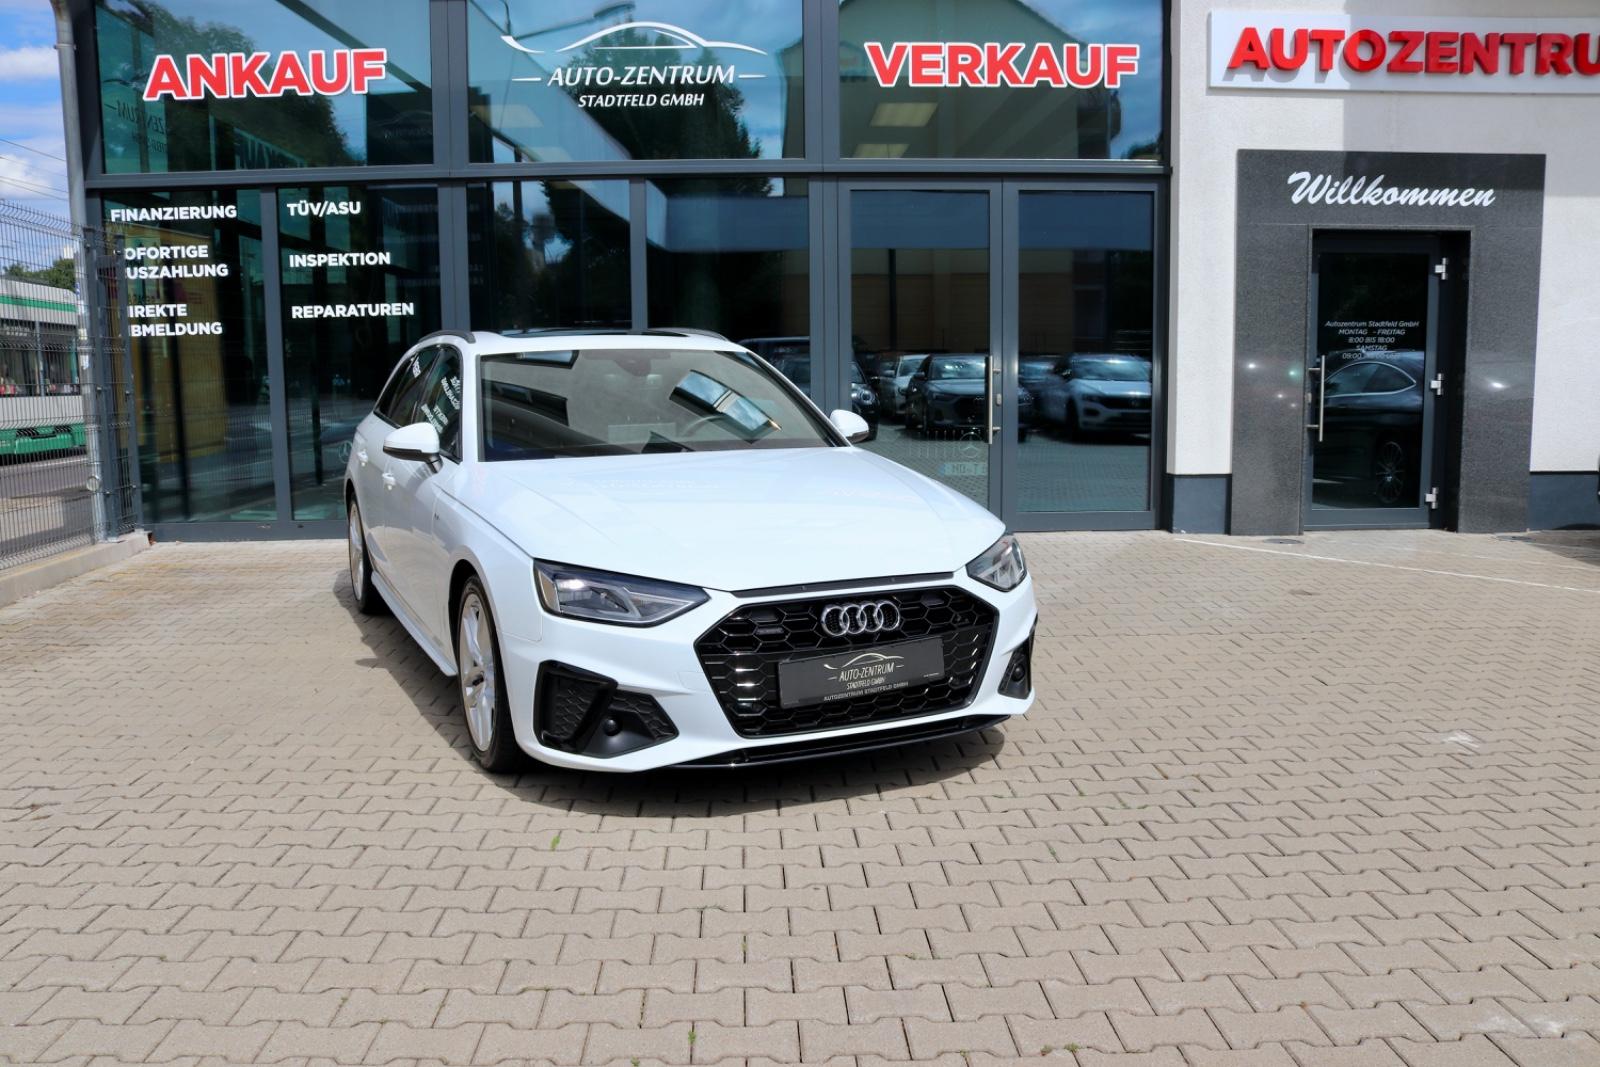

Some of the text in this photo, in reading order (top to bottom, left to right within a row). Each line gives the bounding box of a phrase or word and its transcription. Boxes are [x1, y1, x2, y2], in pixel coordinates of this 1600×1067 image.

[1227, 27, 1600, 77] AUTOZENTRU
[143, 48, 387, 101] ANKAUF
[864, 42, 1140, 89] VERKAUF
[547, 64, 735, 88] AUTO-ZENTRUM
[578, 93, 704, 108] STADTFELD GMBH
[1287, 171, 1496, 207] Willkommen
[110, 205, 237, 222] FINANZIERUNG
[287, 200, 362, 218] TÜV/ASU
[124, 245, 209, 260] OFORTIGE
[289, 251, 391, 269] INSPEKTION
[125, 264, 229, 280] USZAHLUNG
[127, 303, 188, 318] IREKTE
[291, 302, 415, 320] REPARATUREN
[128, 322, 223, 337] BMELDUNG
[838, 662, 895, 682] AUTO-ZENTRUM
